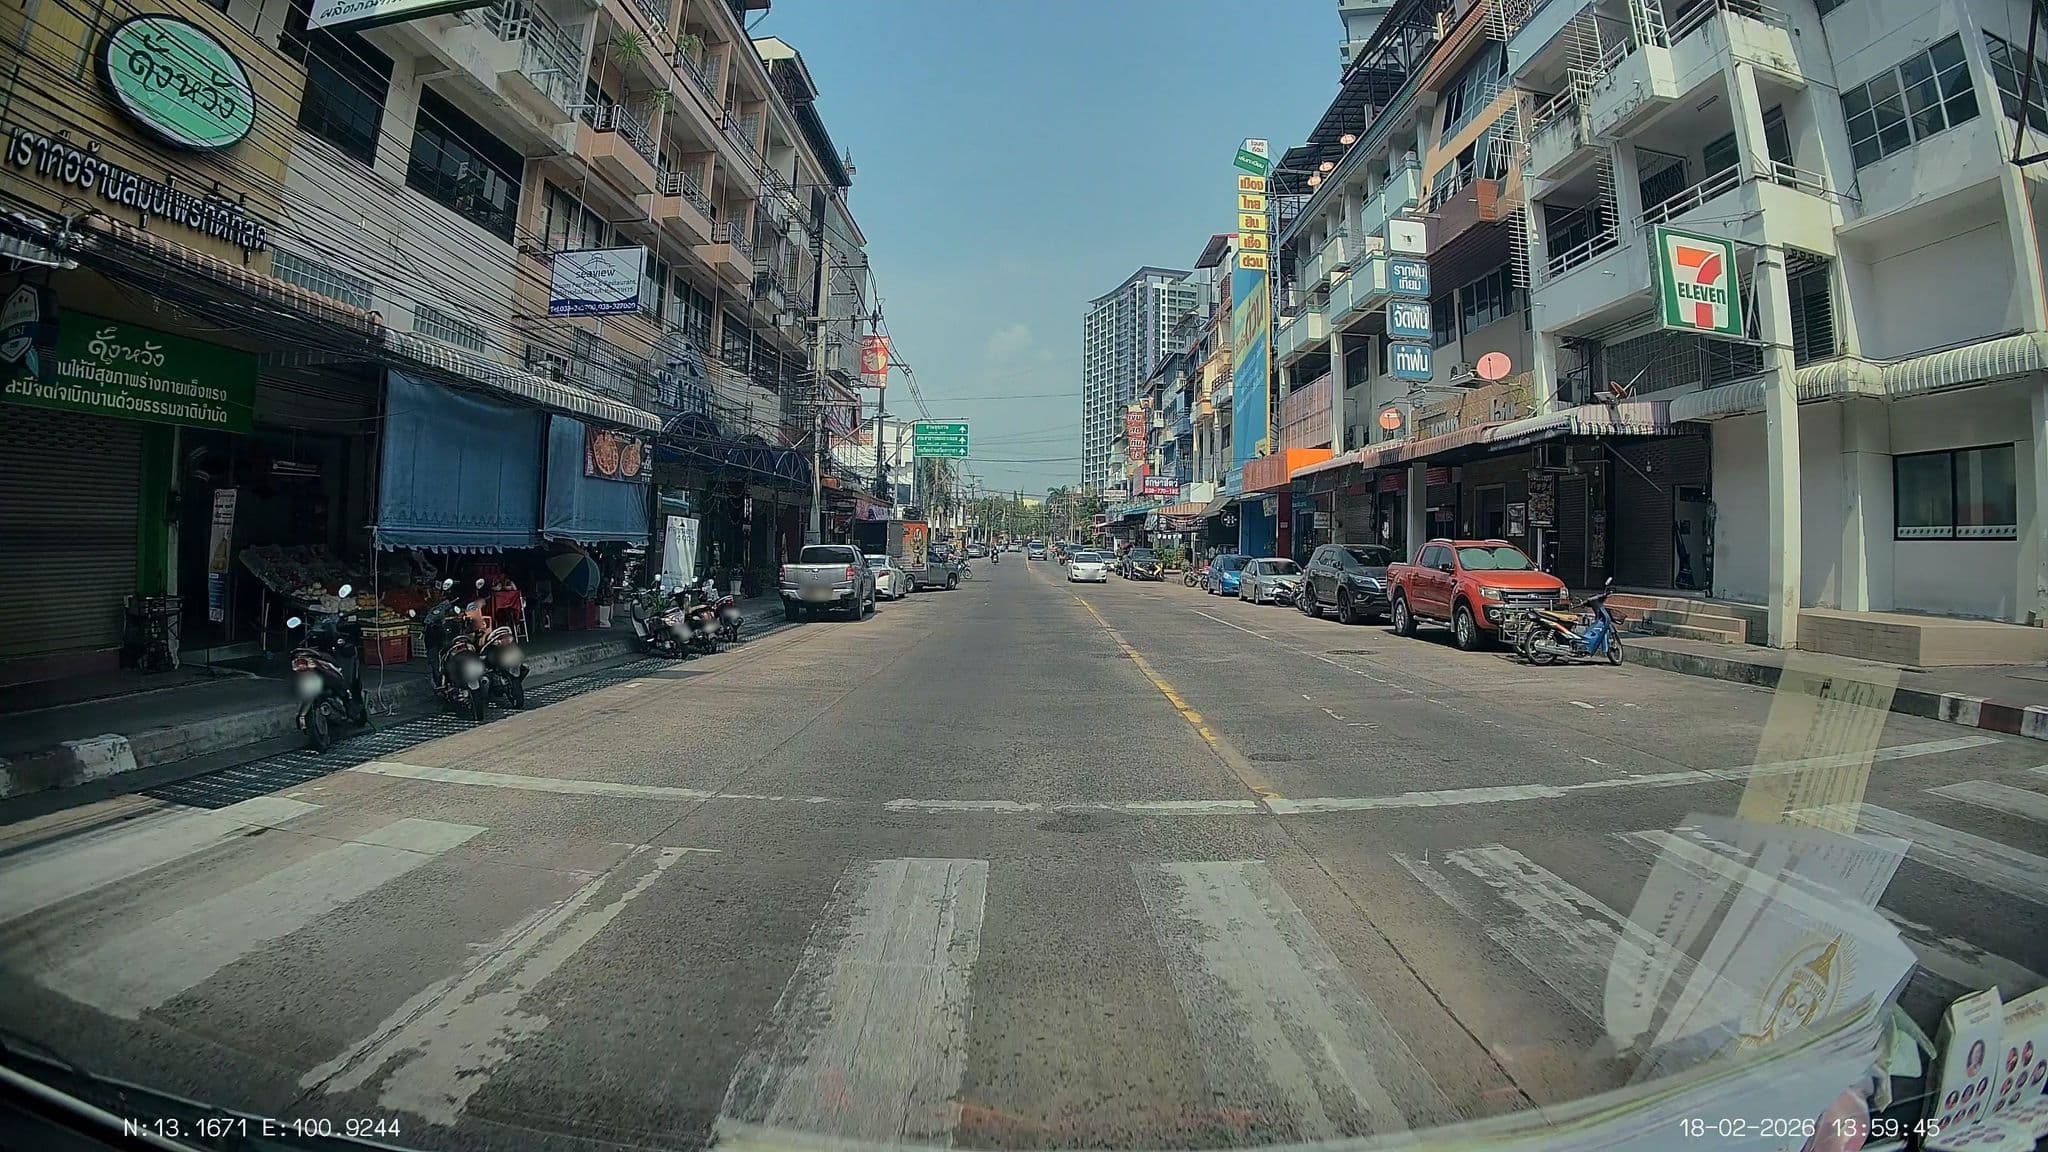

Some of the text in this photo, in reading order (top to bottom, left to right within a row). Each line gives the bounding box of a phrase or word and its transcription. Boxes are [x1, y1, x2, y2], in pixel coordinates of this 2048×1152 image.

[1676, 245, 1723, 329] 7
[1394, 305, 1428, 330] จัดฟัน
[1396, 347, 1428, 372] ทำฟัน
